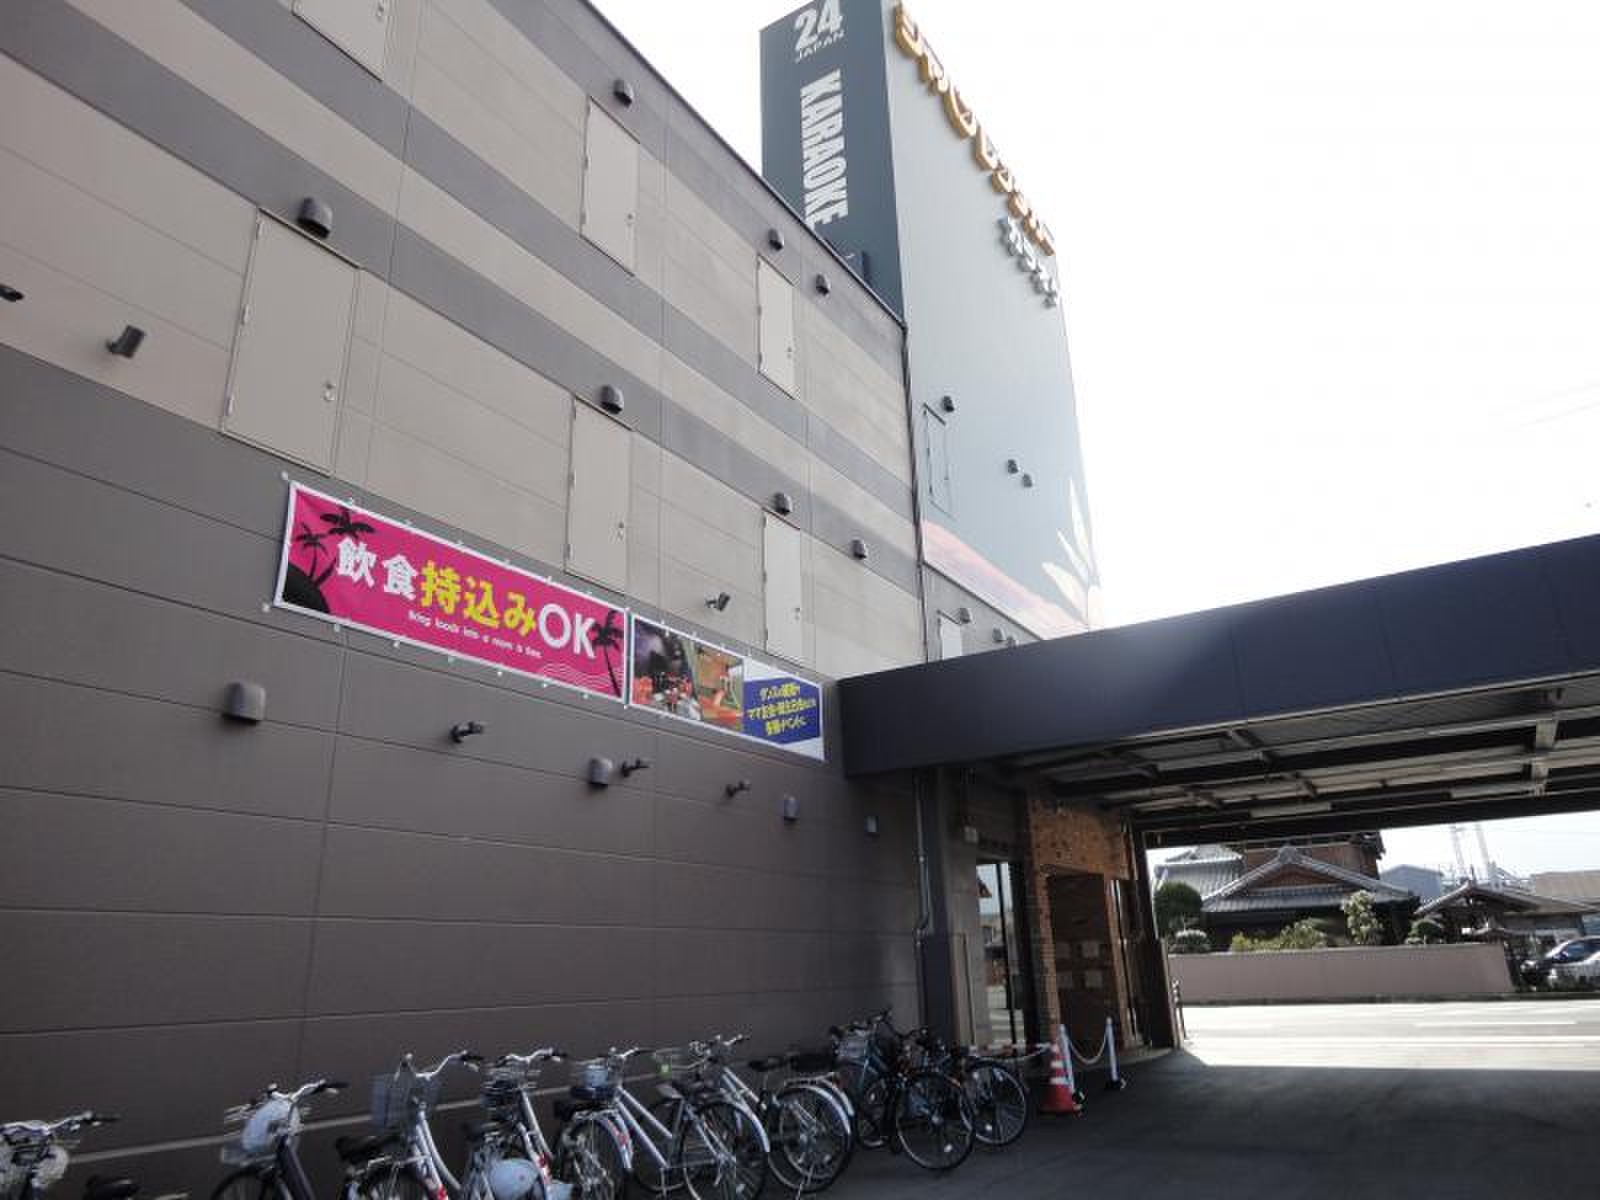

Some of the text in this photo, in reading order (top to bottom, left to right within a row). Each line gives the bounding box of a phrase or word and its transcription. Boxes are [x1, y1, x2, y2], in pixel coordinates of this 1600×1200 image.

[795, 0, 843, 52] 24
[795, 28, 845, 64] JAPAN
[800, 68, 849, 230] KARAOKE
[335, 537, 597, 660] 飲食持込みOK
